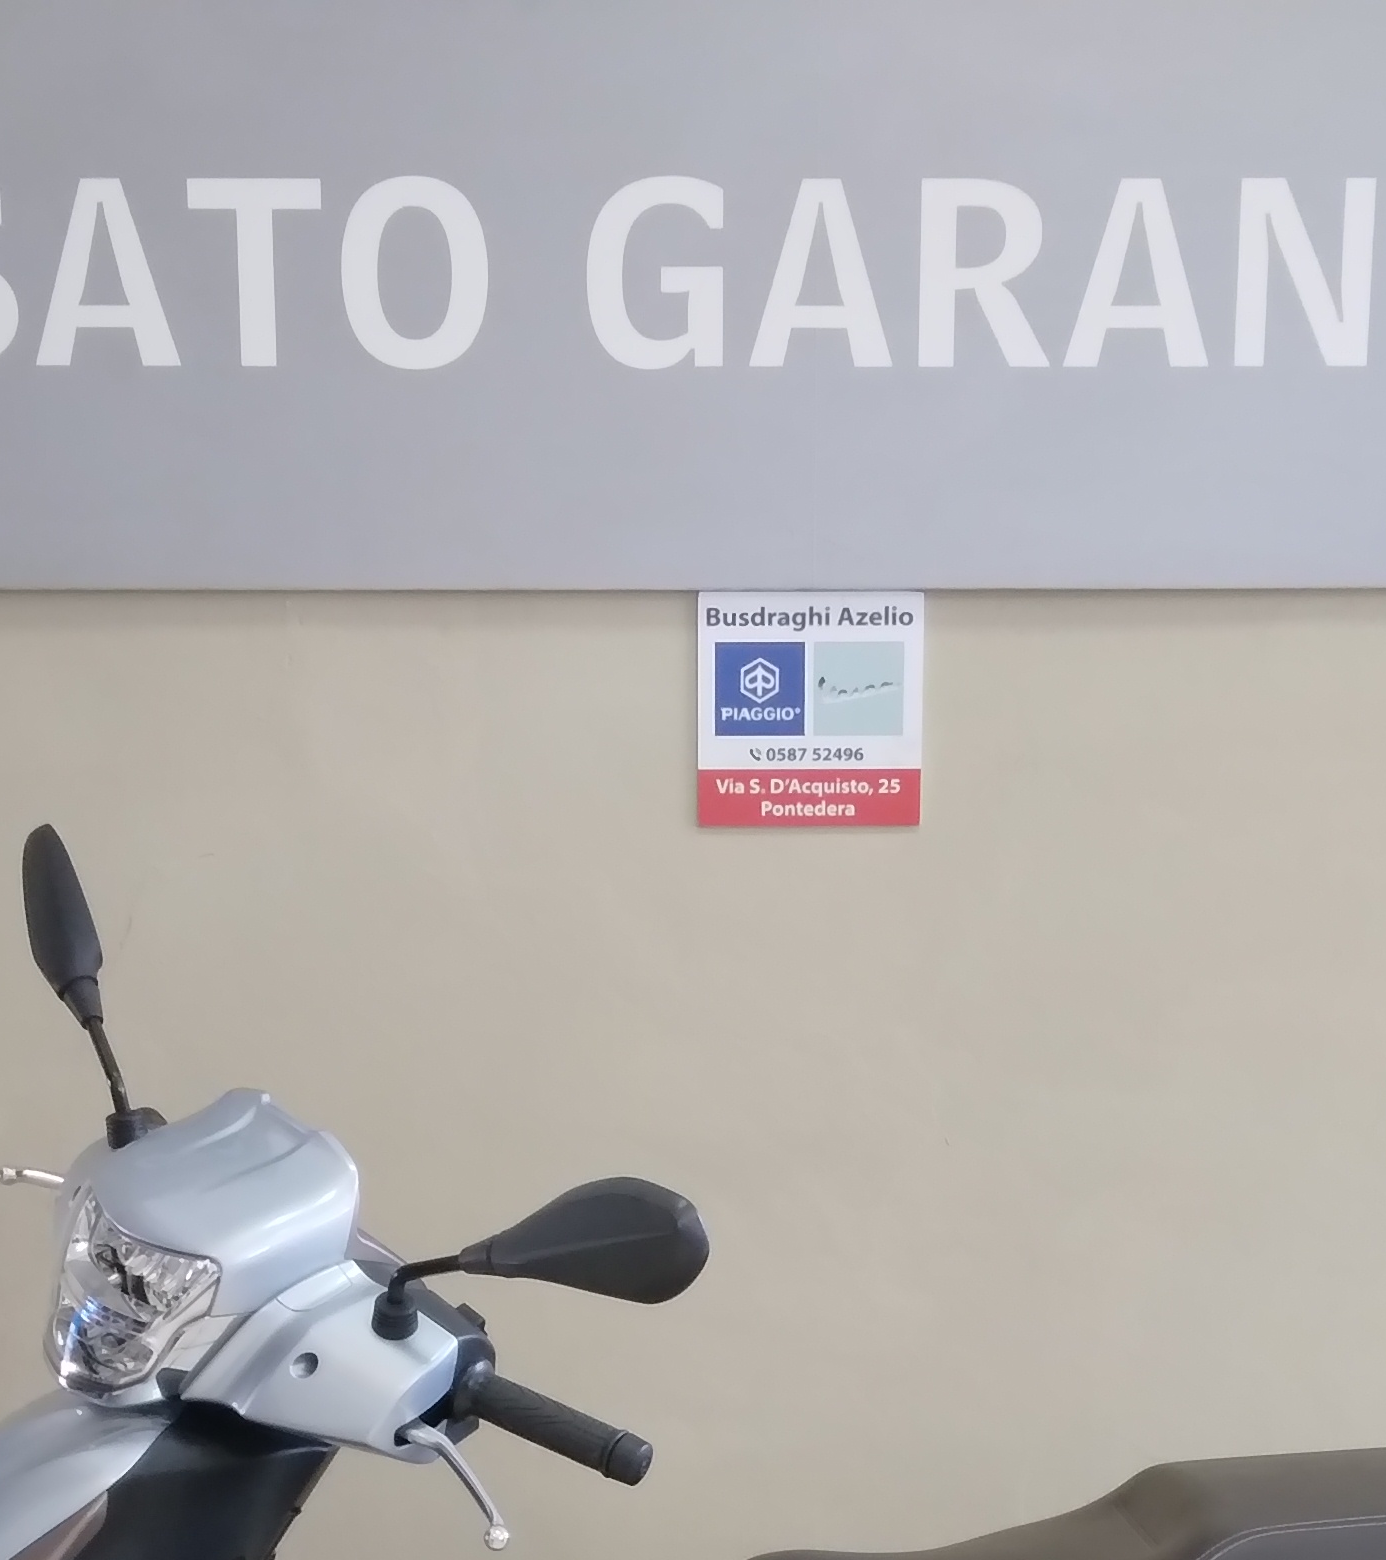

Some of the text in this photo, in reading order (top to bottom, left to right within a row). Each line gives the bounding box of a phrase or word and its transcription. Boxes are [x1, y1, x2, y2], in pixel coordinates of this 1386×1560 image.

[705, 606, 914, 631] Busdraghi Azelio
[766, 747, 864, 762] 0587 52496
[715, 778, 901, 798] Via S. D'Acquisto, 25
[760, 800, 856, 817] Pontedera
